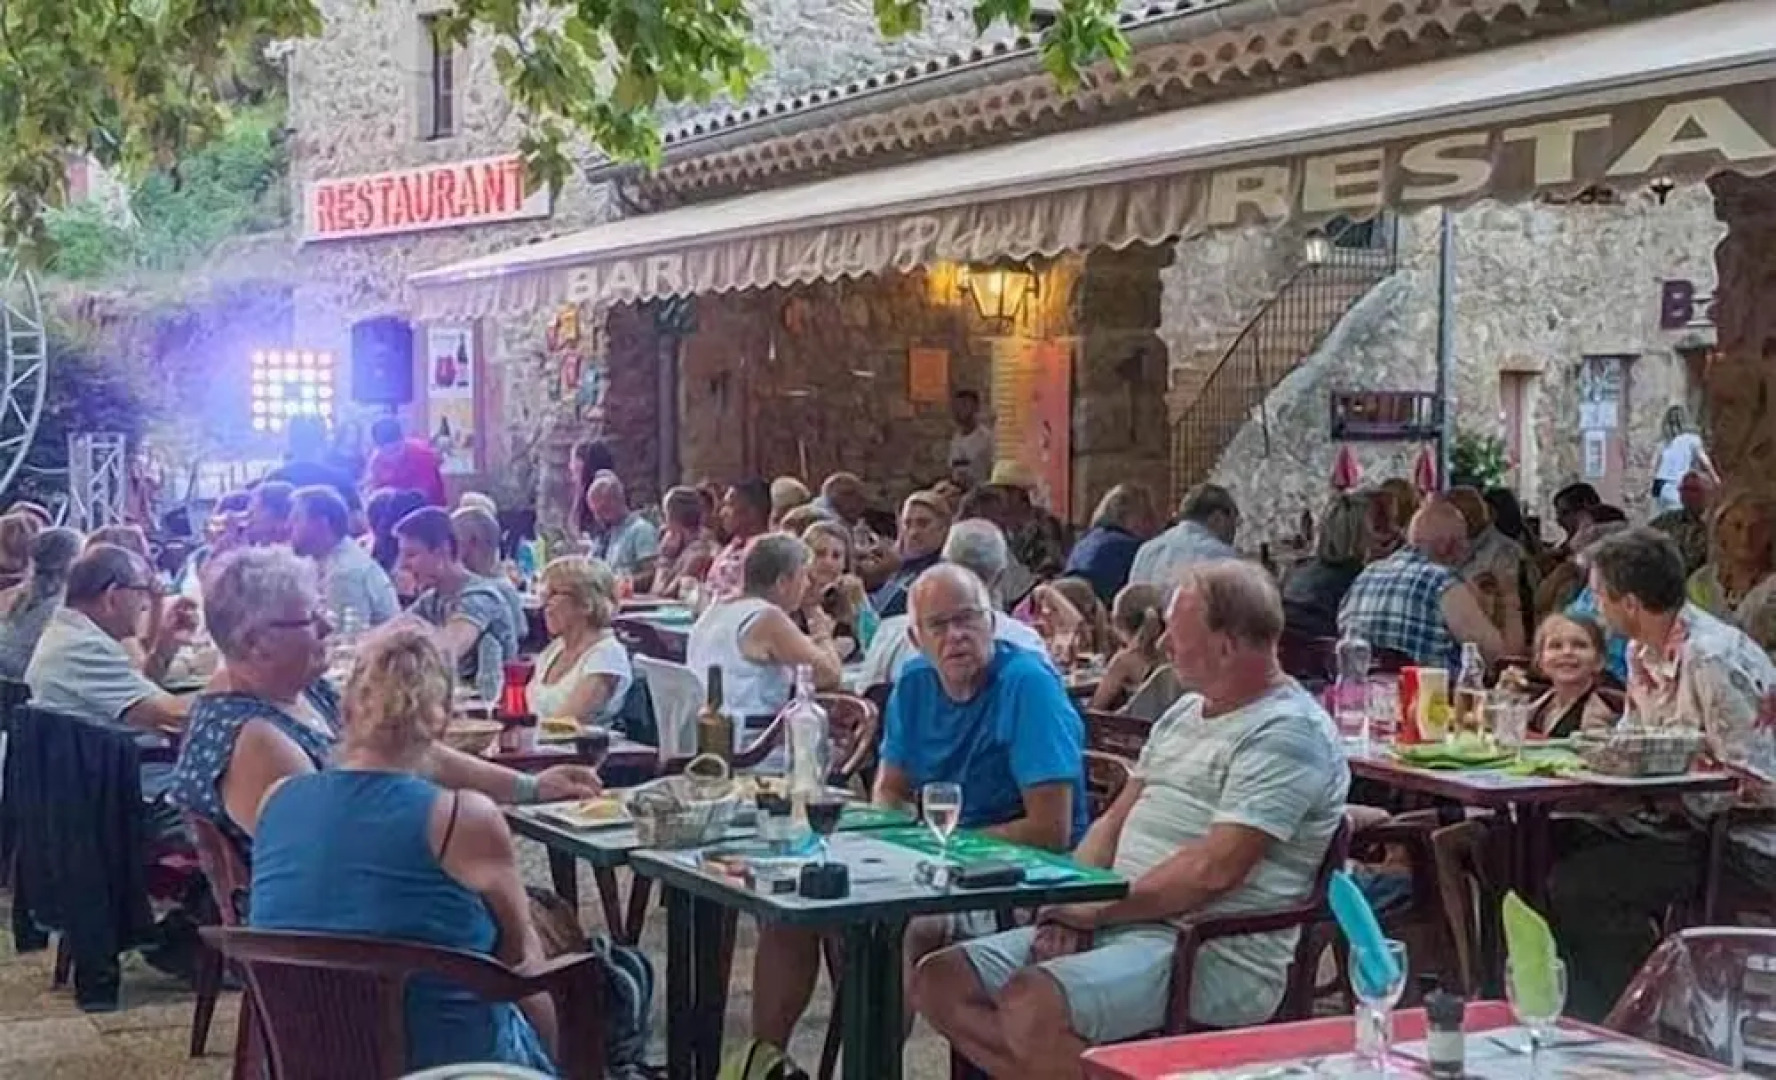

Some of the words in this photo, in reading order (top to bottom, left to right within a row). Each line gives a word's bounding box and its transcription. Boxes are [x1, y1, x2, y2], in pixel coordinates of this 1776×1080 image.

[316, 159, 526, 233] RESTAURANT
[1209, 98, 1776, 229] RESTA
[567, 254, 686, 302] BAR
